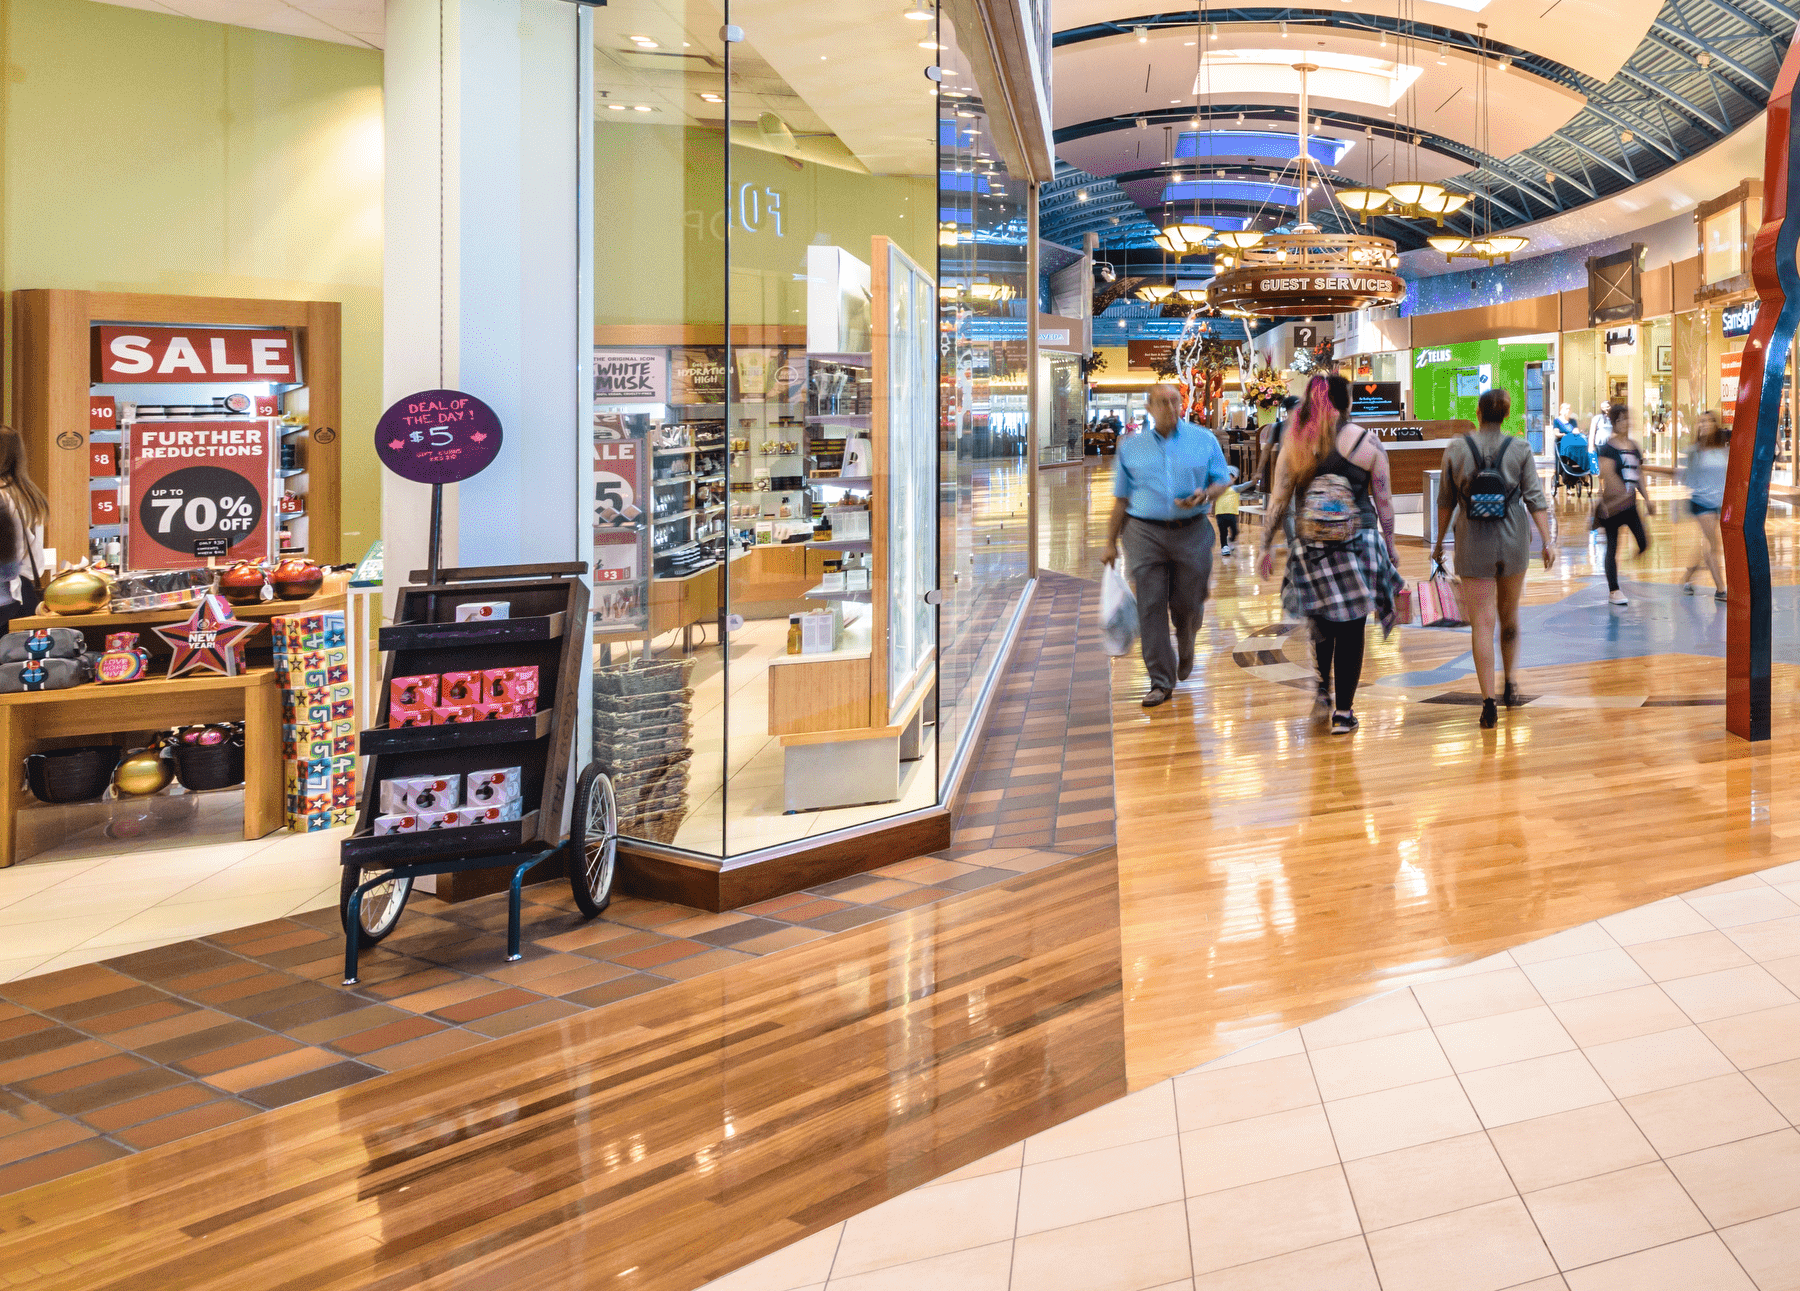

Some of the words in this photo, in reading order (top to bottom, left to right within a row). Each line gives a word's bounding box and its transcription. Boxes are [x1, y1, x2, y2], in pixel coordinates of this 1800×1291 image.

[1260, 277, 1310, 292] GUEST
[1314, 277, 1393, 292] SERVICES
[109, 334, 291, 375] SALE
[1427, 349, 1452, 364] TELUS
[597, 361, 650, 376] WHITE
[595, 375, 654, 390] MUSK
[694, 375, 718, 384] HIGH
[91, 406, 113, 419] $10
[259, 405, 273, 416] $9
[408, 400, 449, 414] DEAL
[450, 398, 469, 410] OF
[402, 413, 433, 426] THE
[438, 410, 464, 424] DAY
[141, 429, 263, 446] FURTHER
[1390, 426, 1424, 437] KIOSK
[141, 445, 263, 459] REDUCTIONS
[94, 454, 110, 465] $8
[151, 489, 167, 497] UP
[169, 488, 184, 496] TO
[97, 501, 113, 513] $5
[281, 501, 296, 511] $5
[219, 517, 253, 532] OFF
[603, 570, 618, 580] $3
[188, 633, 217, 643] NEW
